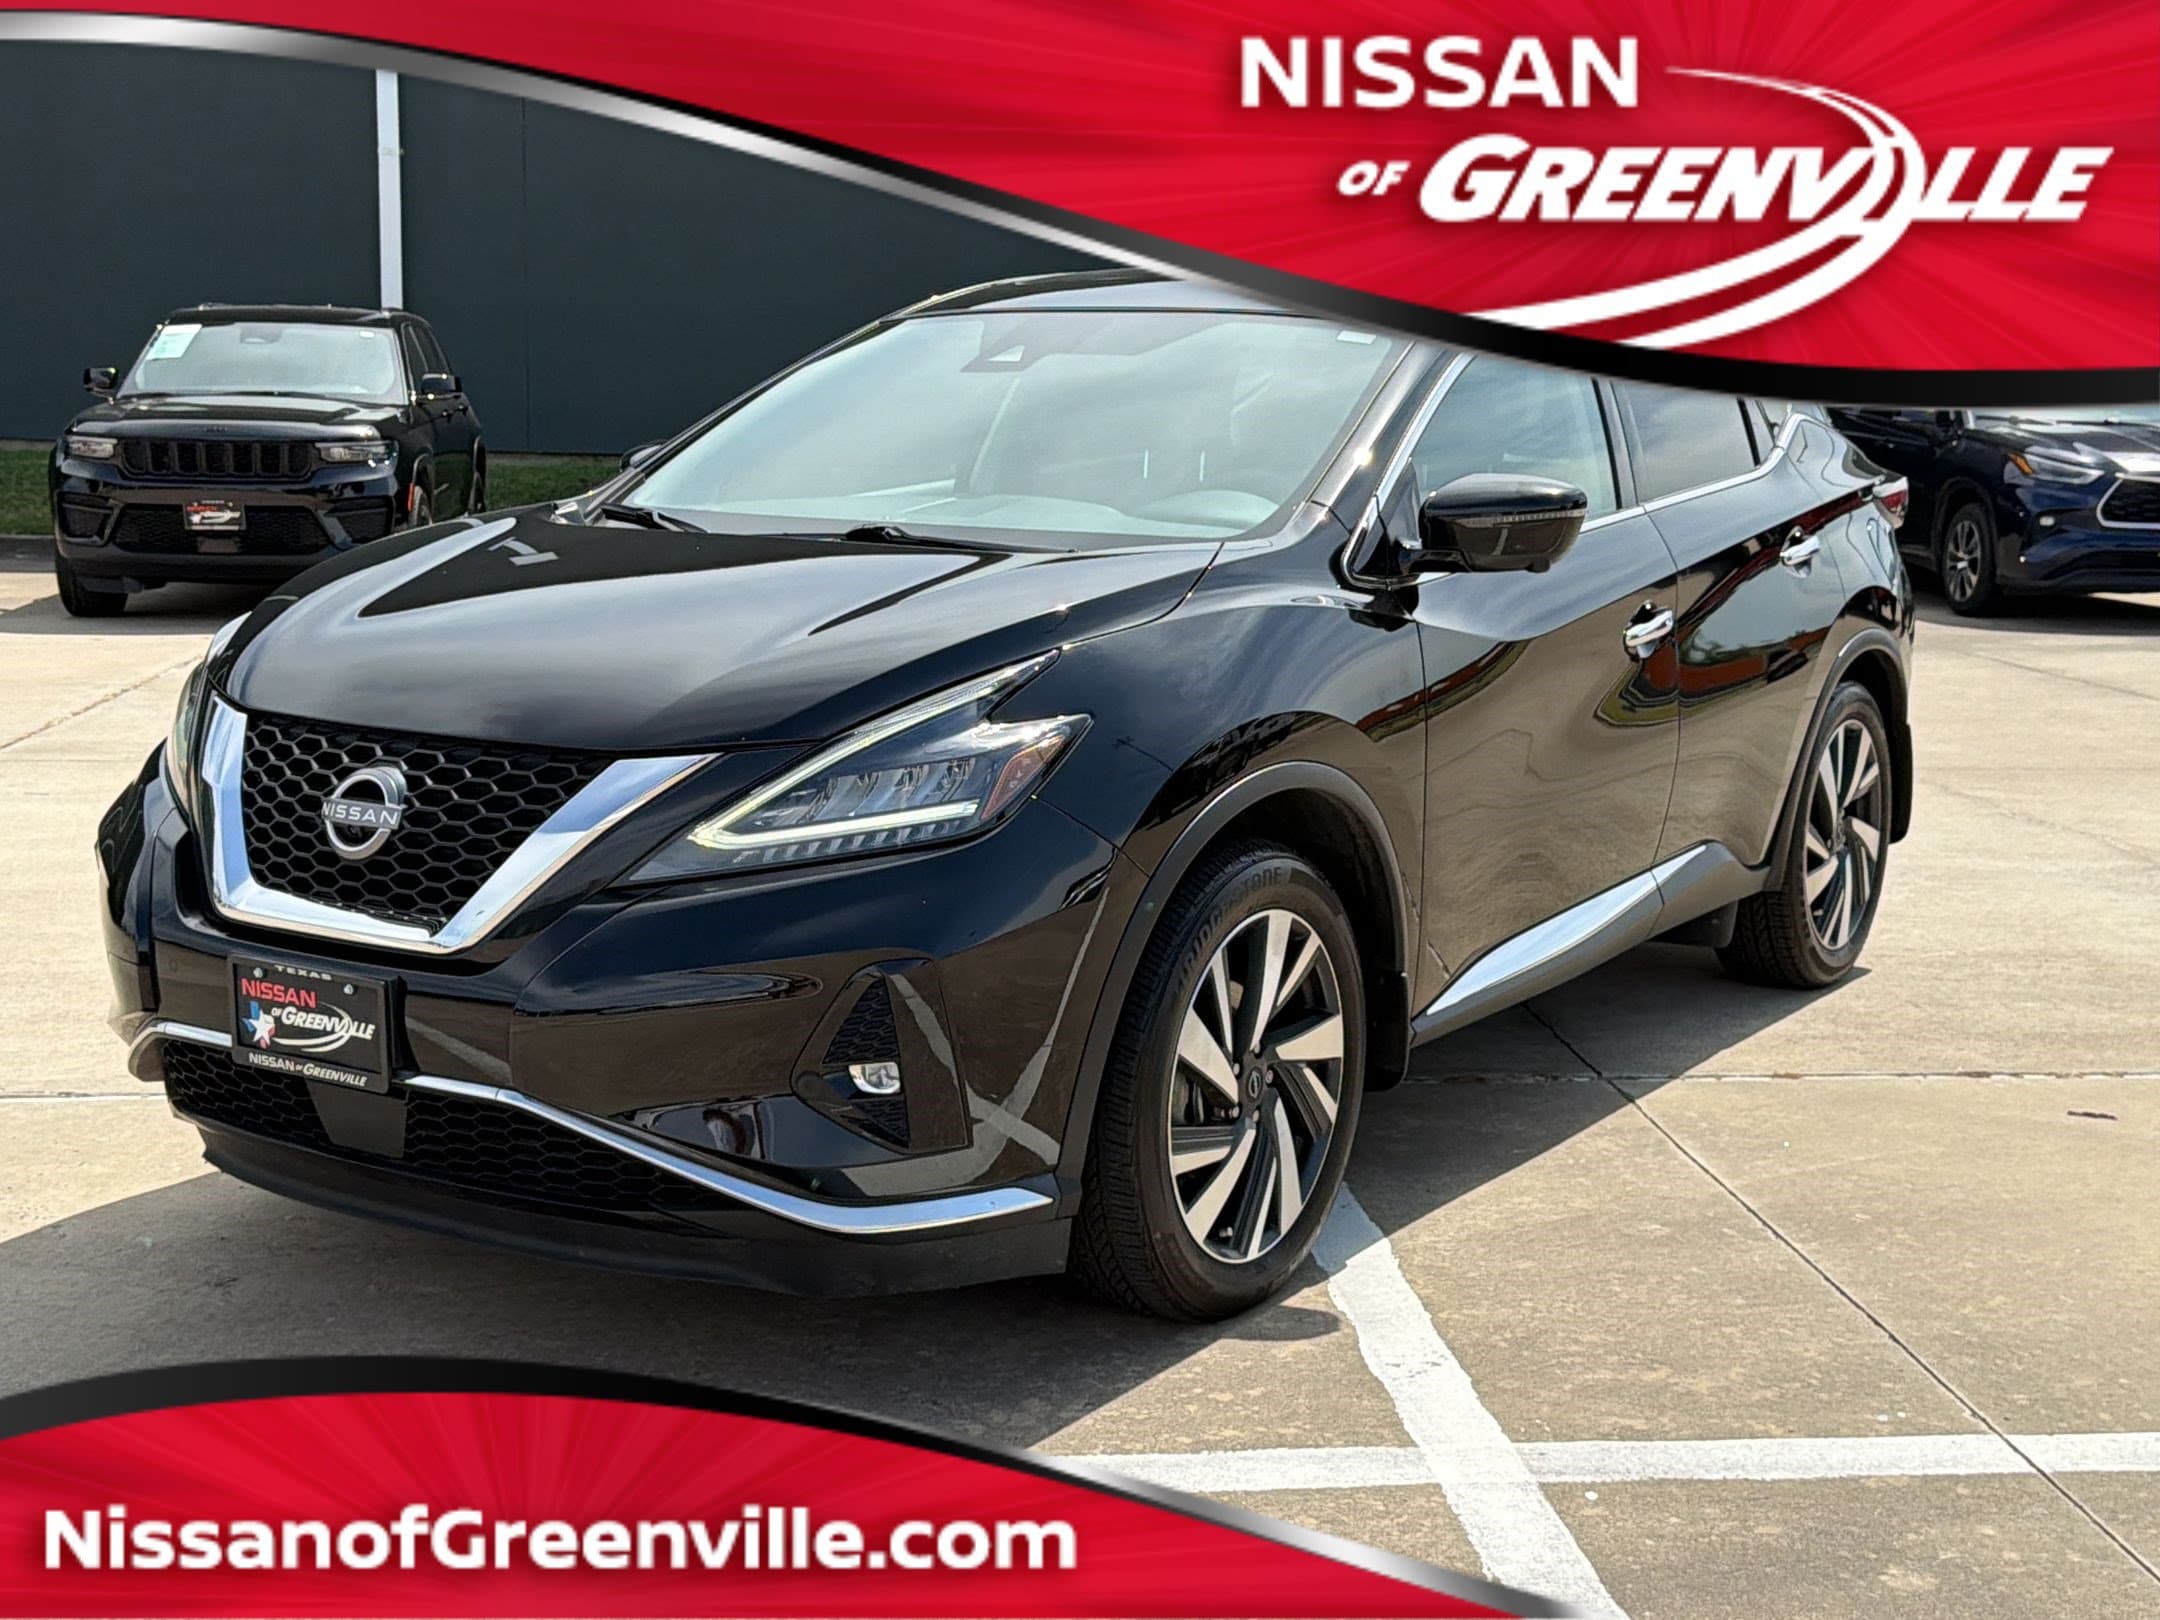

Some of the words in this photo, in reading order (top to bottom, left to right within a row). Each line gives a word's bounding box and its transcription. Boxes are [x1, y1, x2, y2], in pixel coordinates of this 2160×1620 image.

[322, 802, 398, 825] NISSAN
[274, 965, 332, 981] TEXAS
[241, 978, 317, 1008] NISSAN
[271, 1007, 282, 1017] OF
[281, 1006, 376, 1040] GREENVILLE
[249, 1052, 295, 1071] NISSAN
[303, 1063, 368, 1087] GREENVILLE
